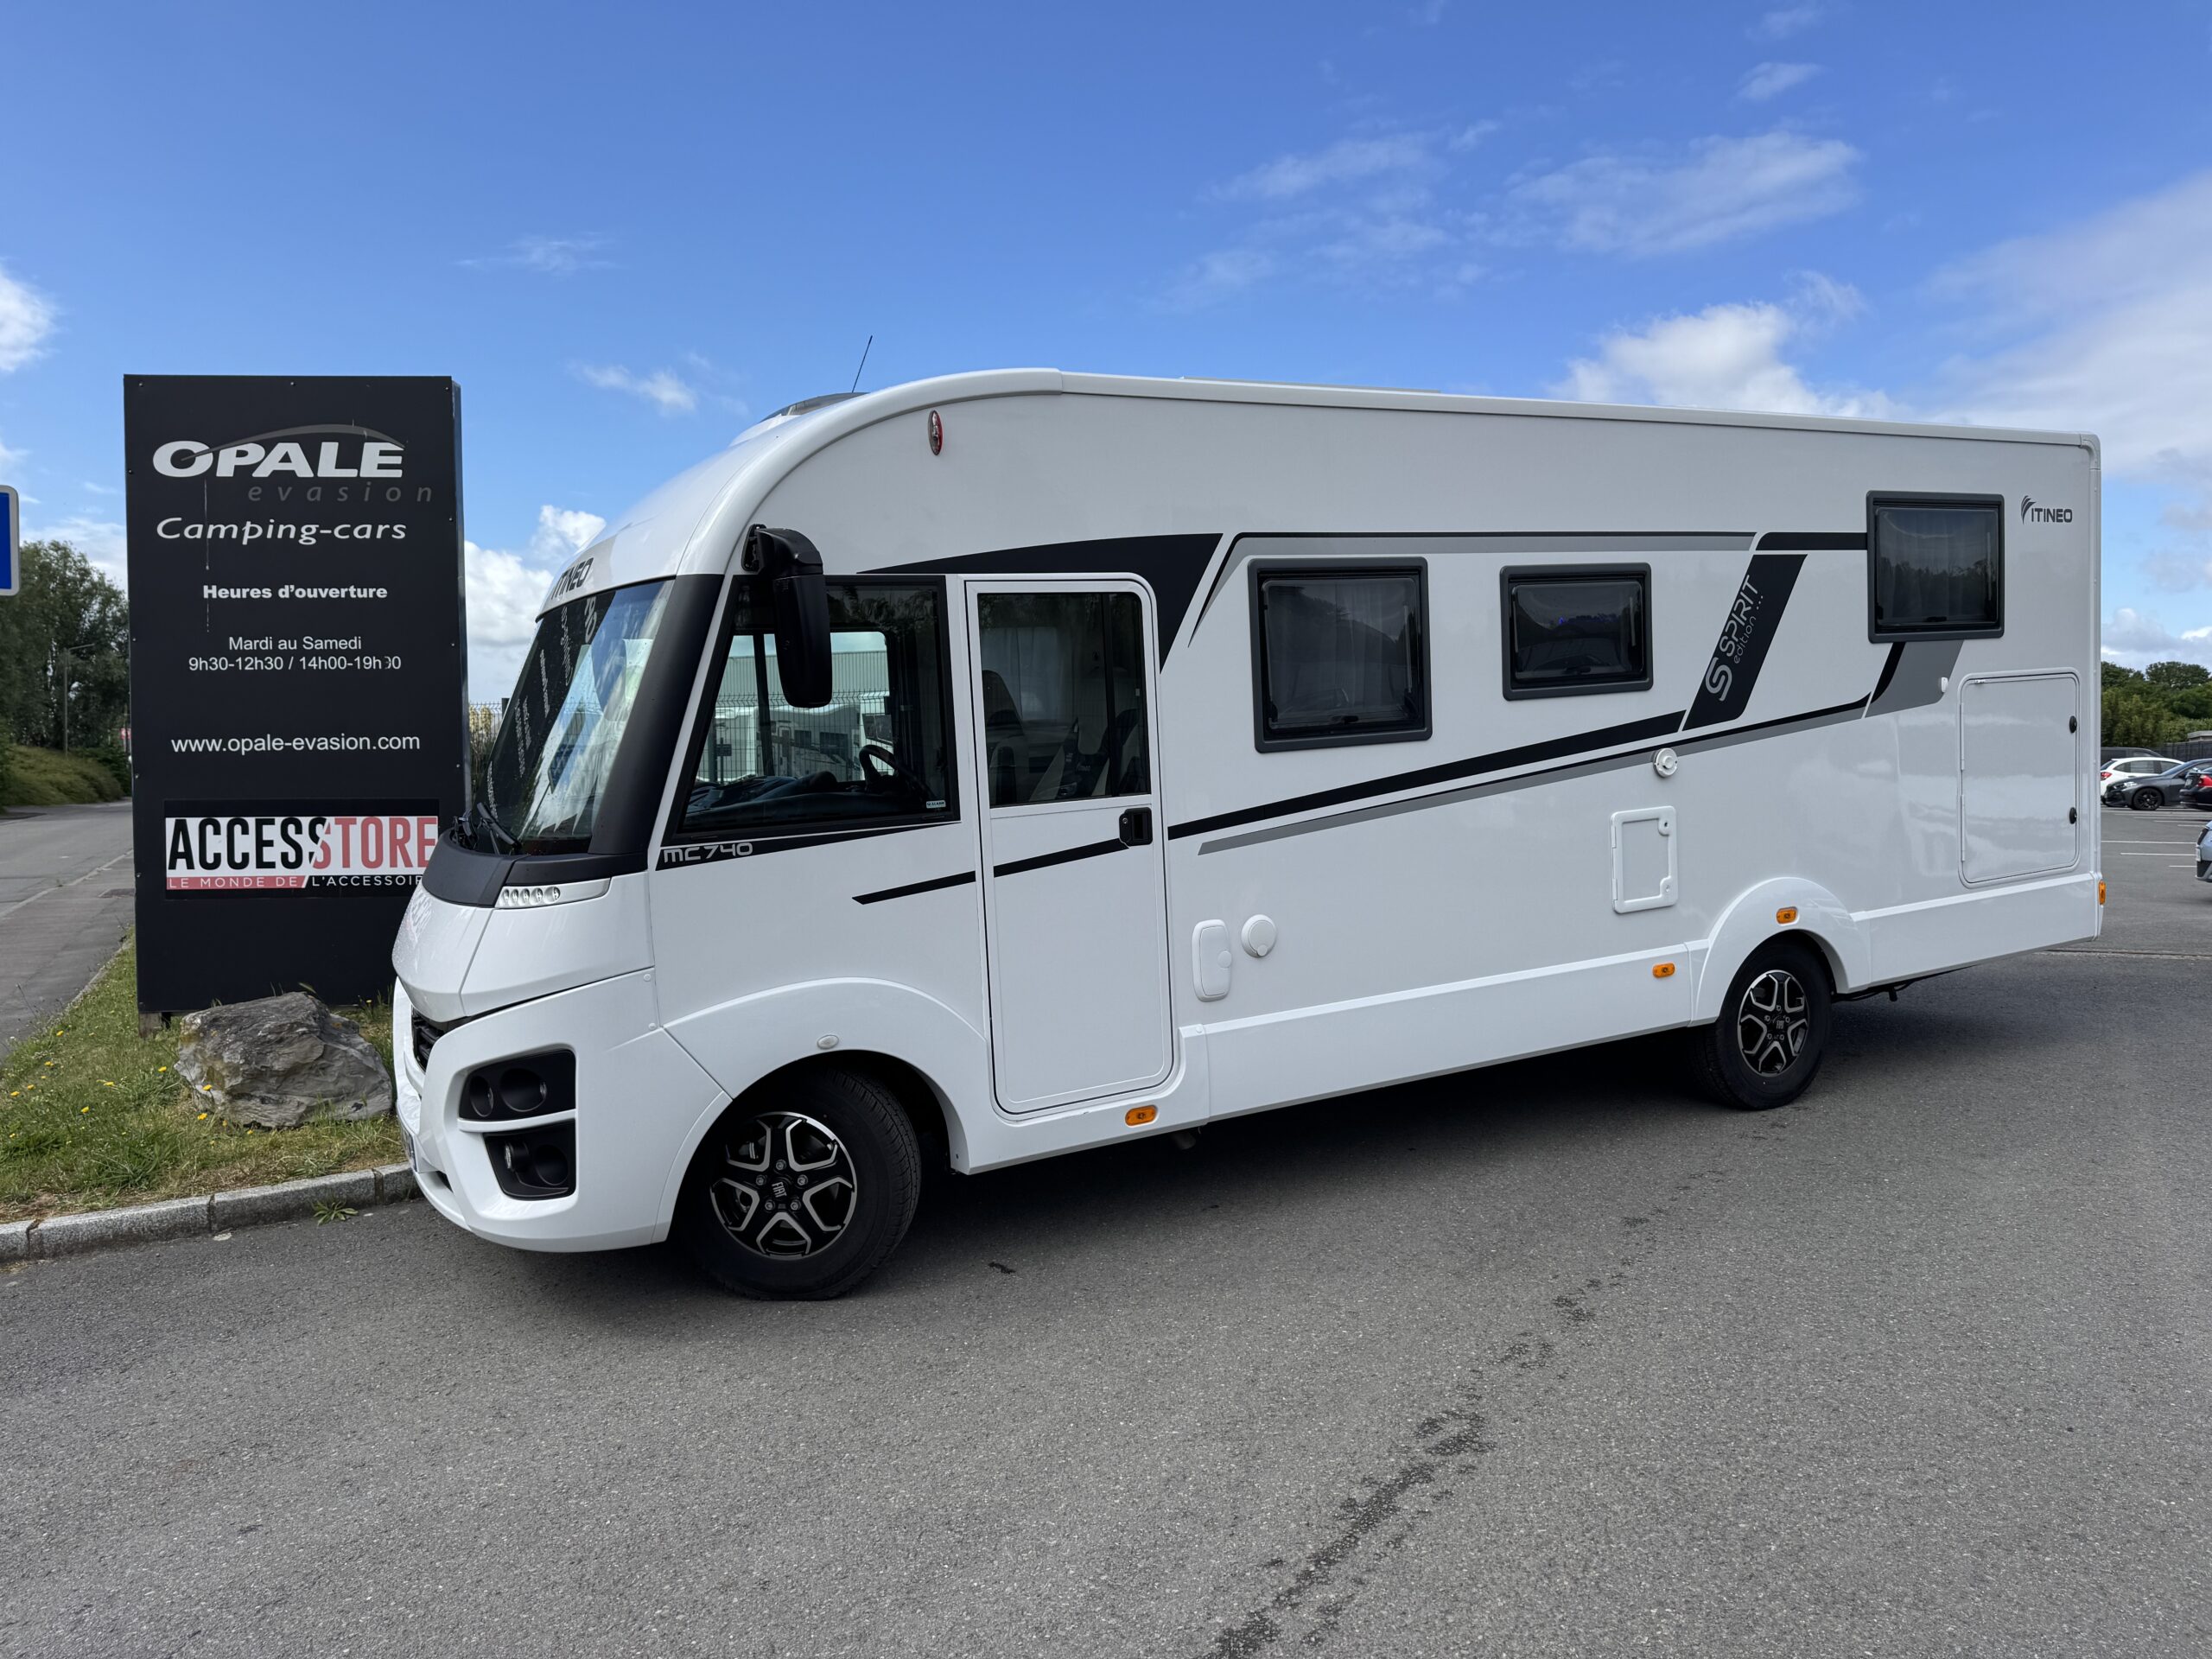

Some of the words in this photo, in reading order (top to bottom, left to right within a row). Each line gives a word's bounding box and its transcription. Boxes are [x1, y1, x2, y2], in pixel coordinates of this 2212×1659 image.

[153, 441, 404, 477] OPALE
[247, 481, 432, 502] evasion
[2031, 508, 2073, 523] ITINEO
[156, 518, 407, 544] Camping-cars
[203, 585, 272, 599] Heures
[277, 585, 388, 599] d'ouverture
[1719, 575, 1758, 657] SPIRIT
[229, 637, 273, 651] Mardi
[277, 639, 297, 651] au
[302, 636, 362, 650] Samedi
[1733, 616, 1757, 664] edition
[188, 657, 284, 671] 9h30-12h30
[171, 734, 420, 755] www.opale-evasion.com
[168, 877, 189, 888] LE
[200, 876, 270, 887] MONDE
[276, 876, 298, 887] DE
